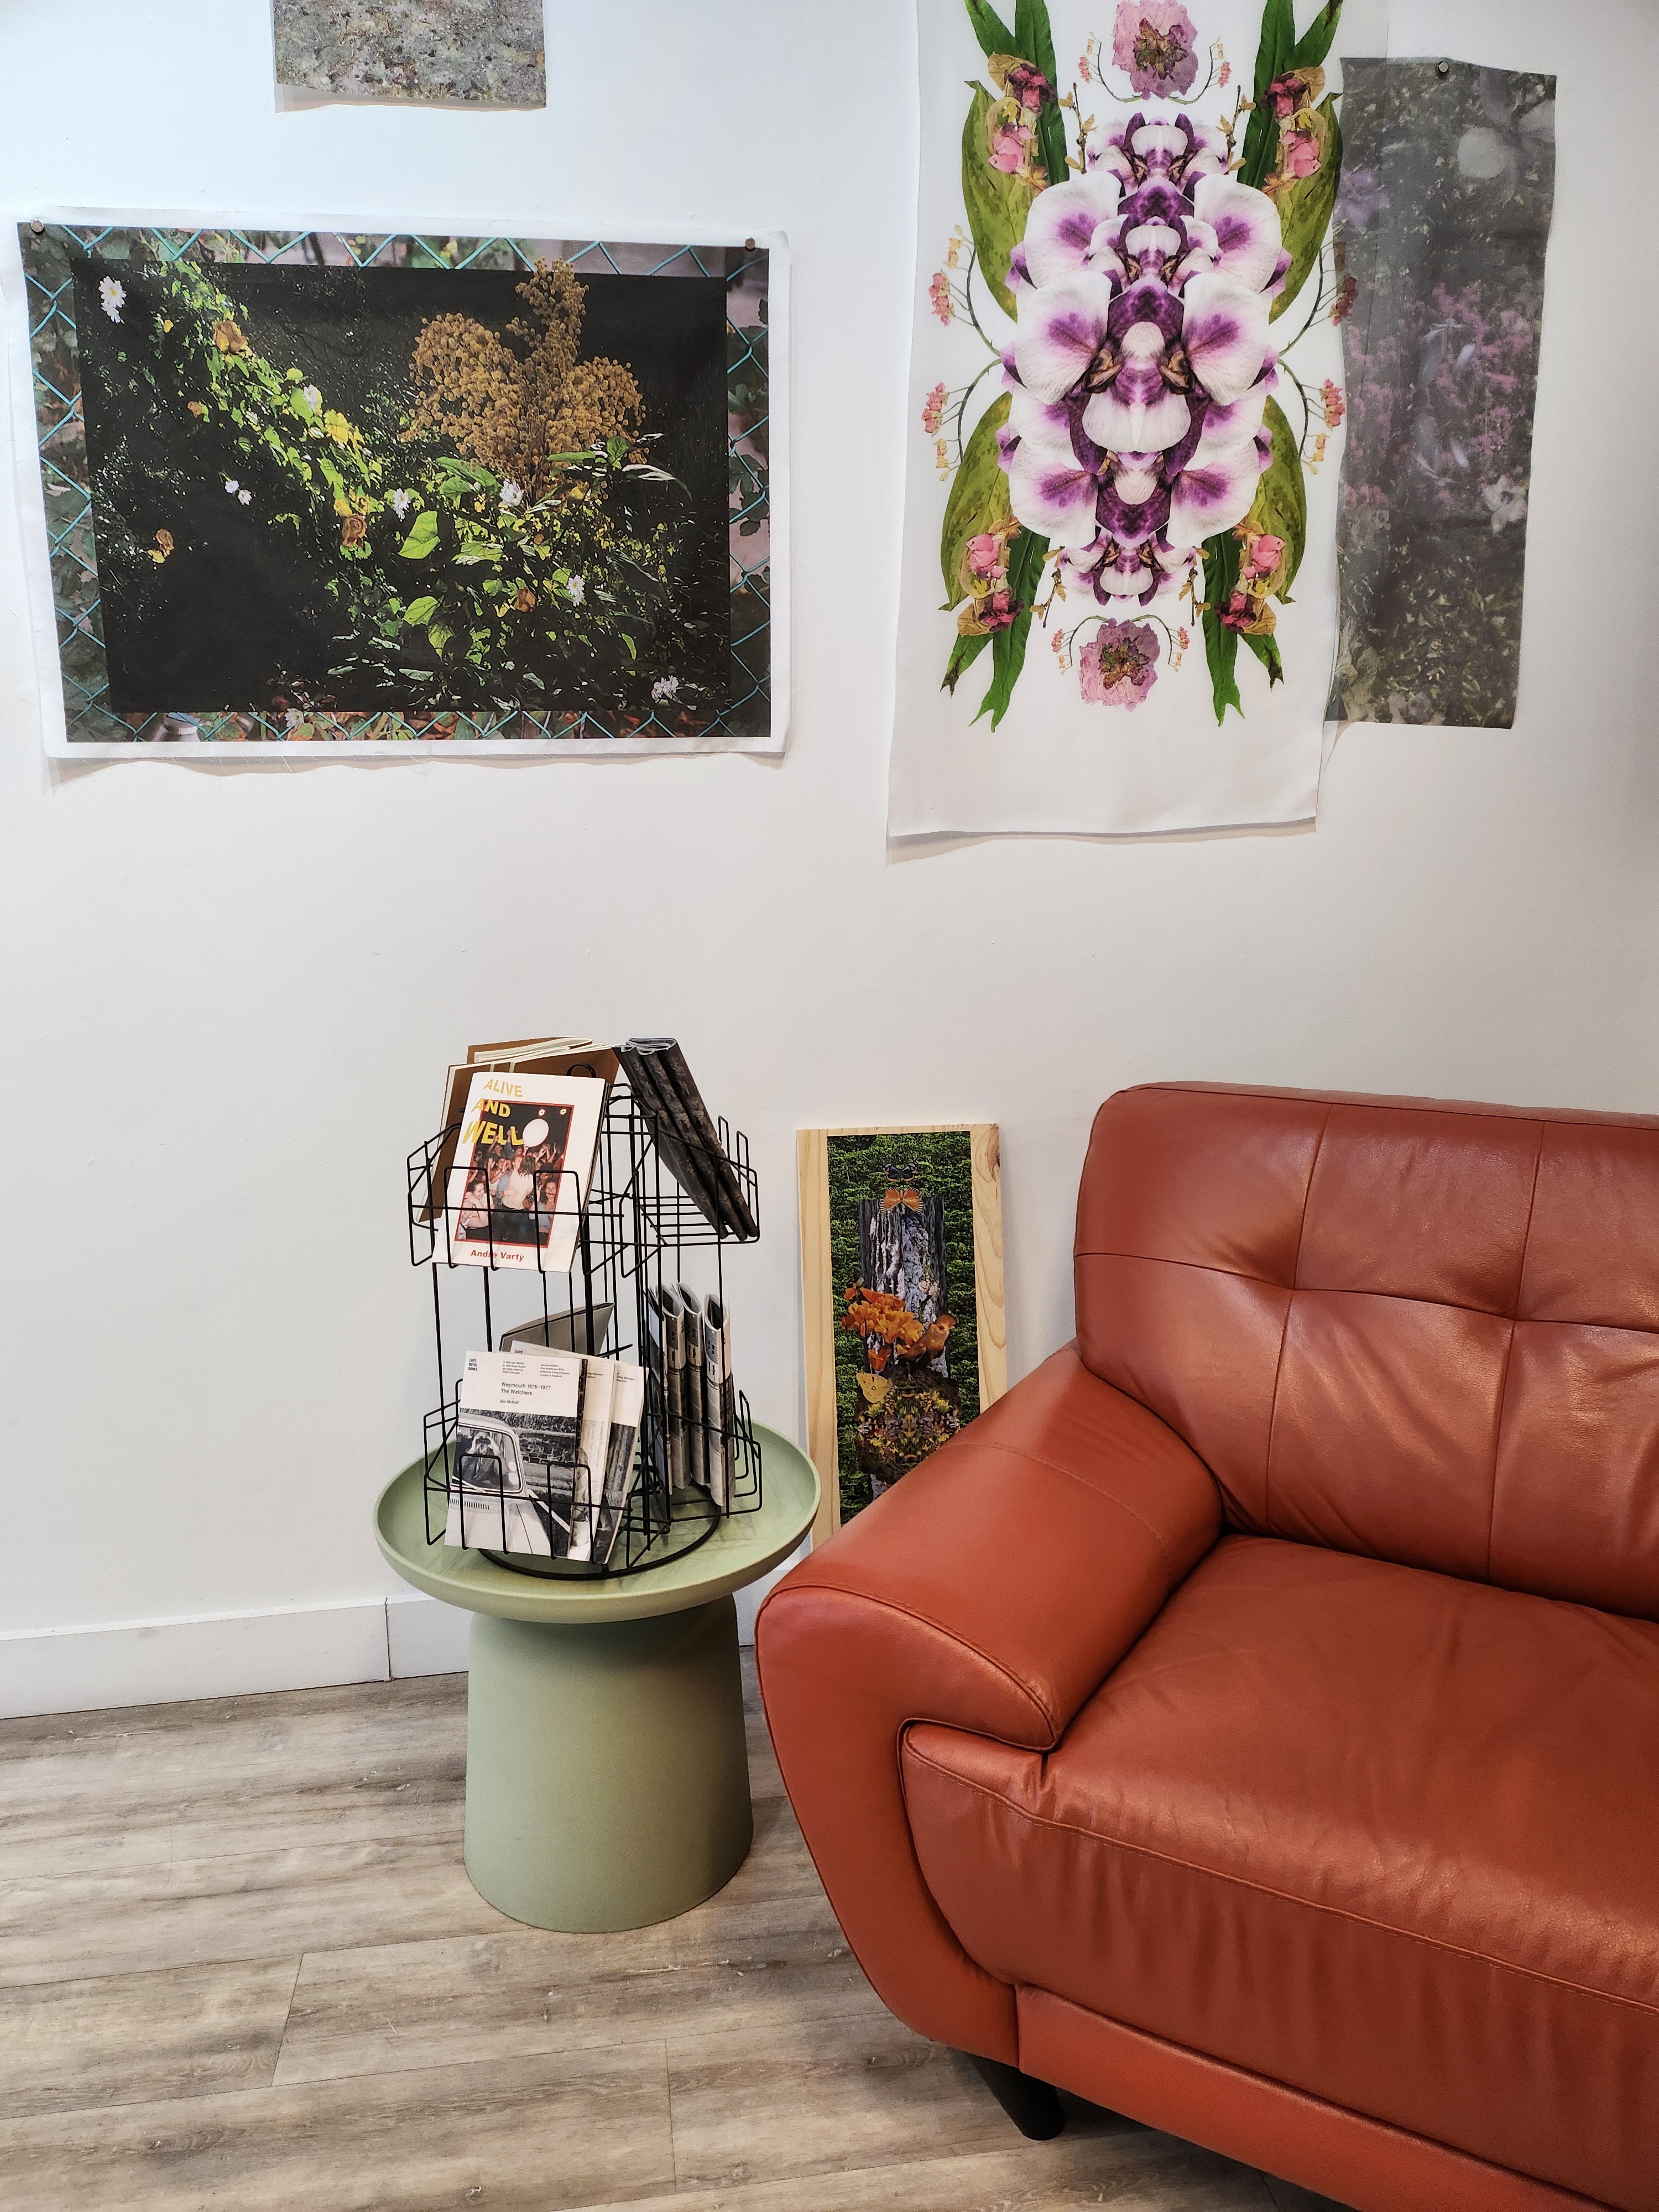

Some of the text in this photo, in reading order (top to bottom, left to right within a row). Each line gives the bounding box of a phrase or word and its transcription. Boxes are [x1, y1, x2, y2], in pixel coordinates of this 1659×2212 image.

[483, 1079, 523, 1097] ALIVE
[471, 1098, 510, 1118] AND
[462, 1120, 525, 1146] WELL
[500, 1252, 524, 1262] Varty
